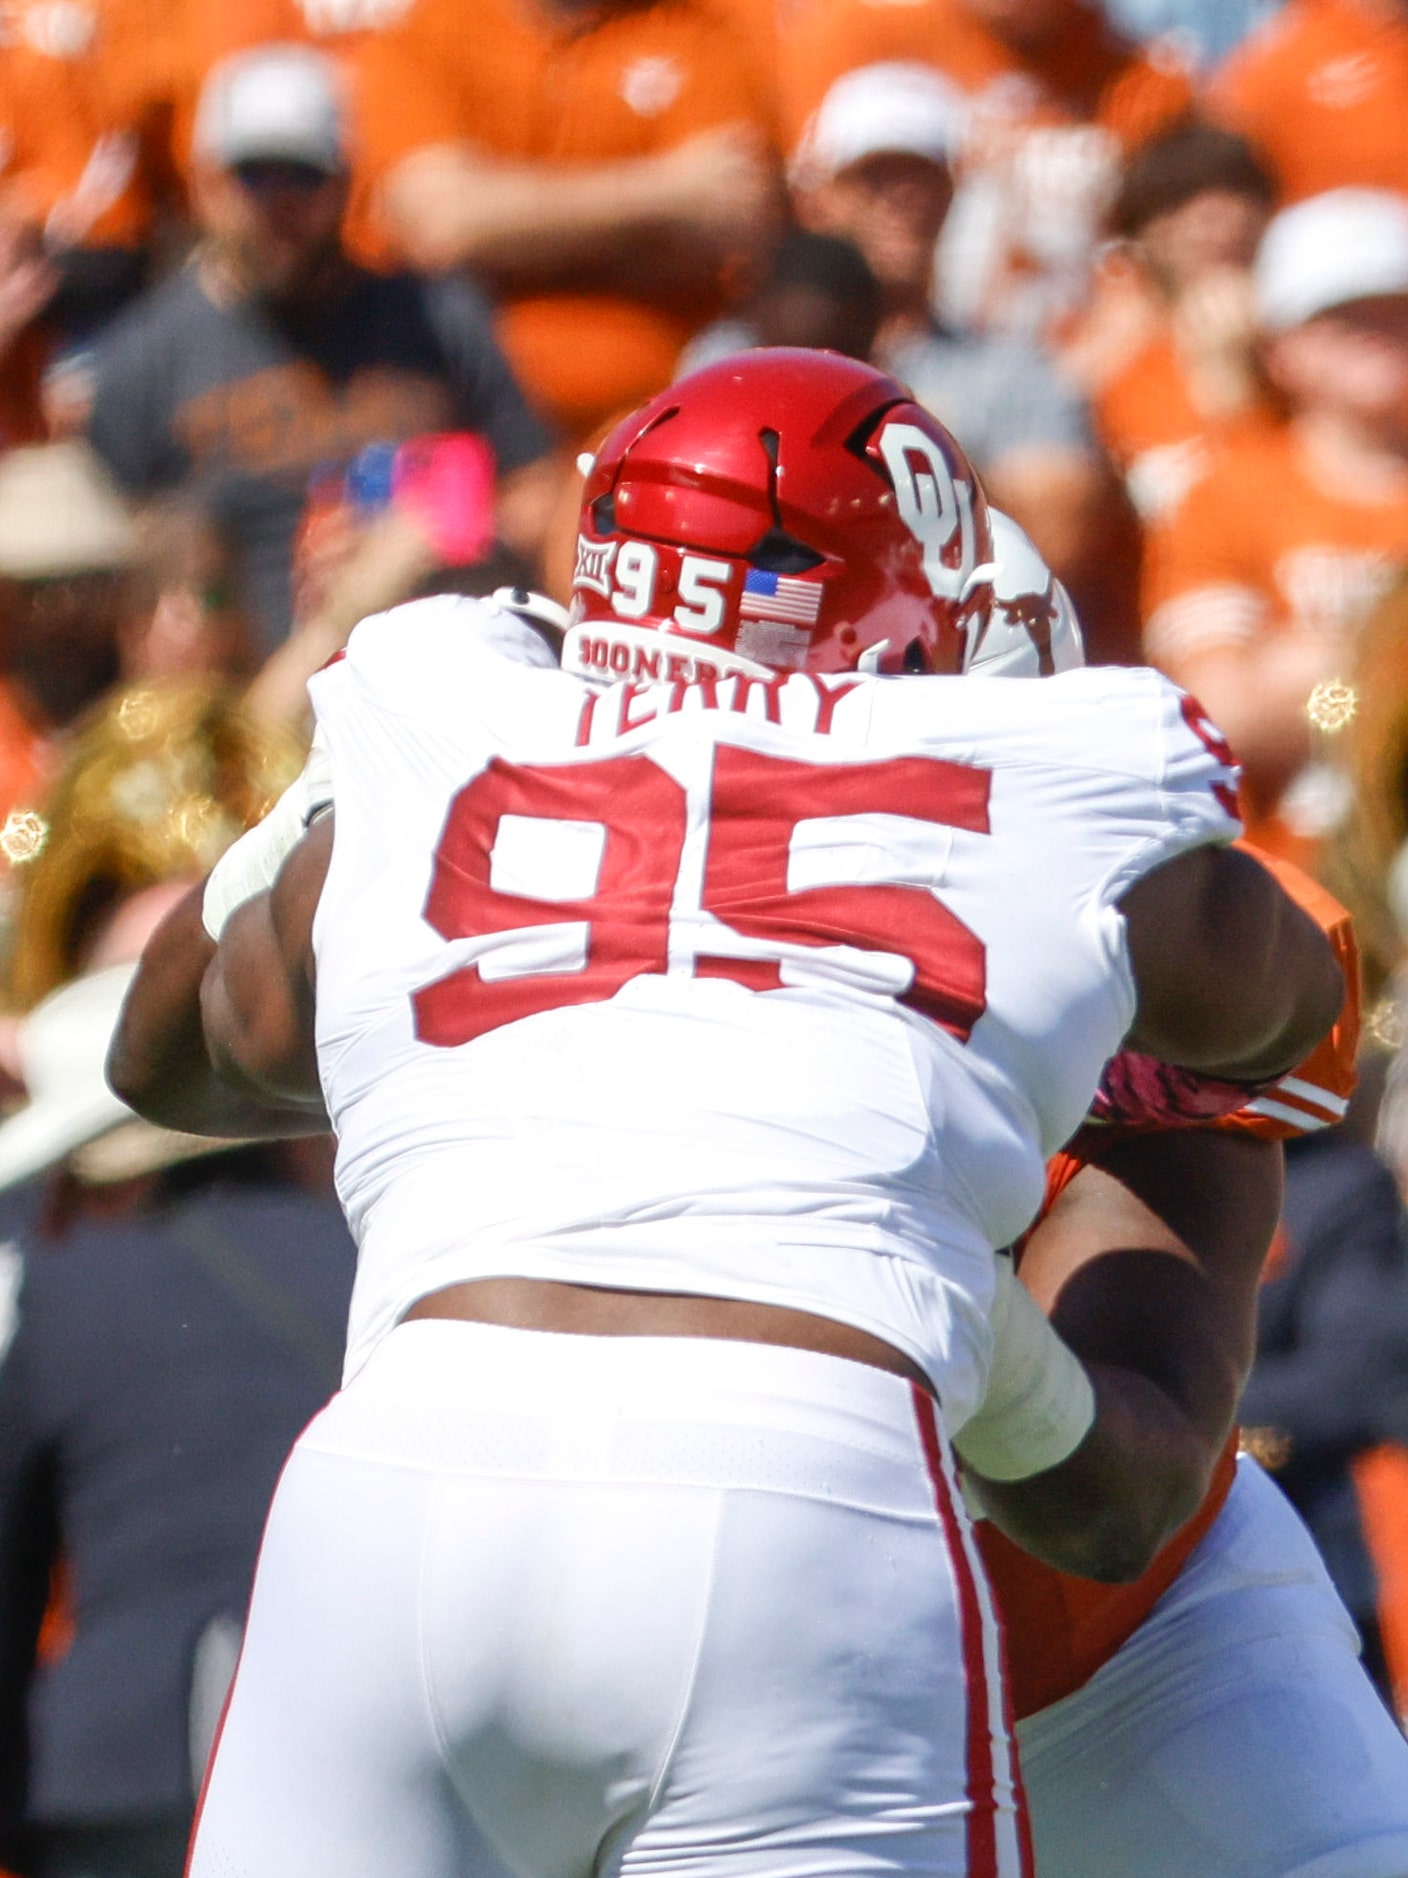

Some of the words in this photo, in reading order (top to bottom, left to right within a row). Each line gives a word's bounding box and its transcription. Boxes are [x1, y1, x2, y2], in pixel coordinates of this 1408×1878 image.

[611, 541, 731, 633] 95
[879, 423, 977, 600] OU
[409, 742, 992, 1048] 95
